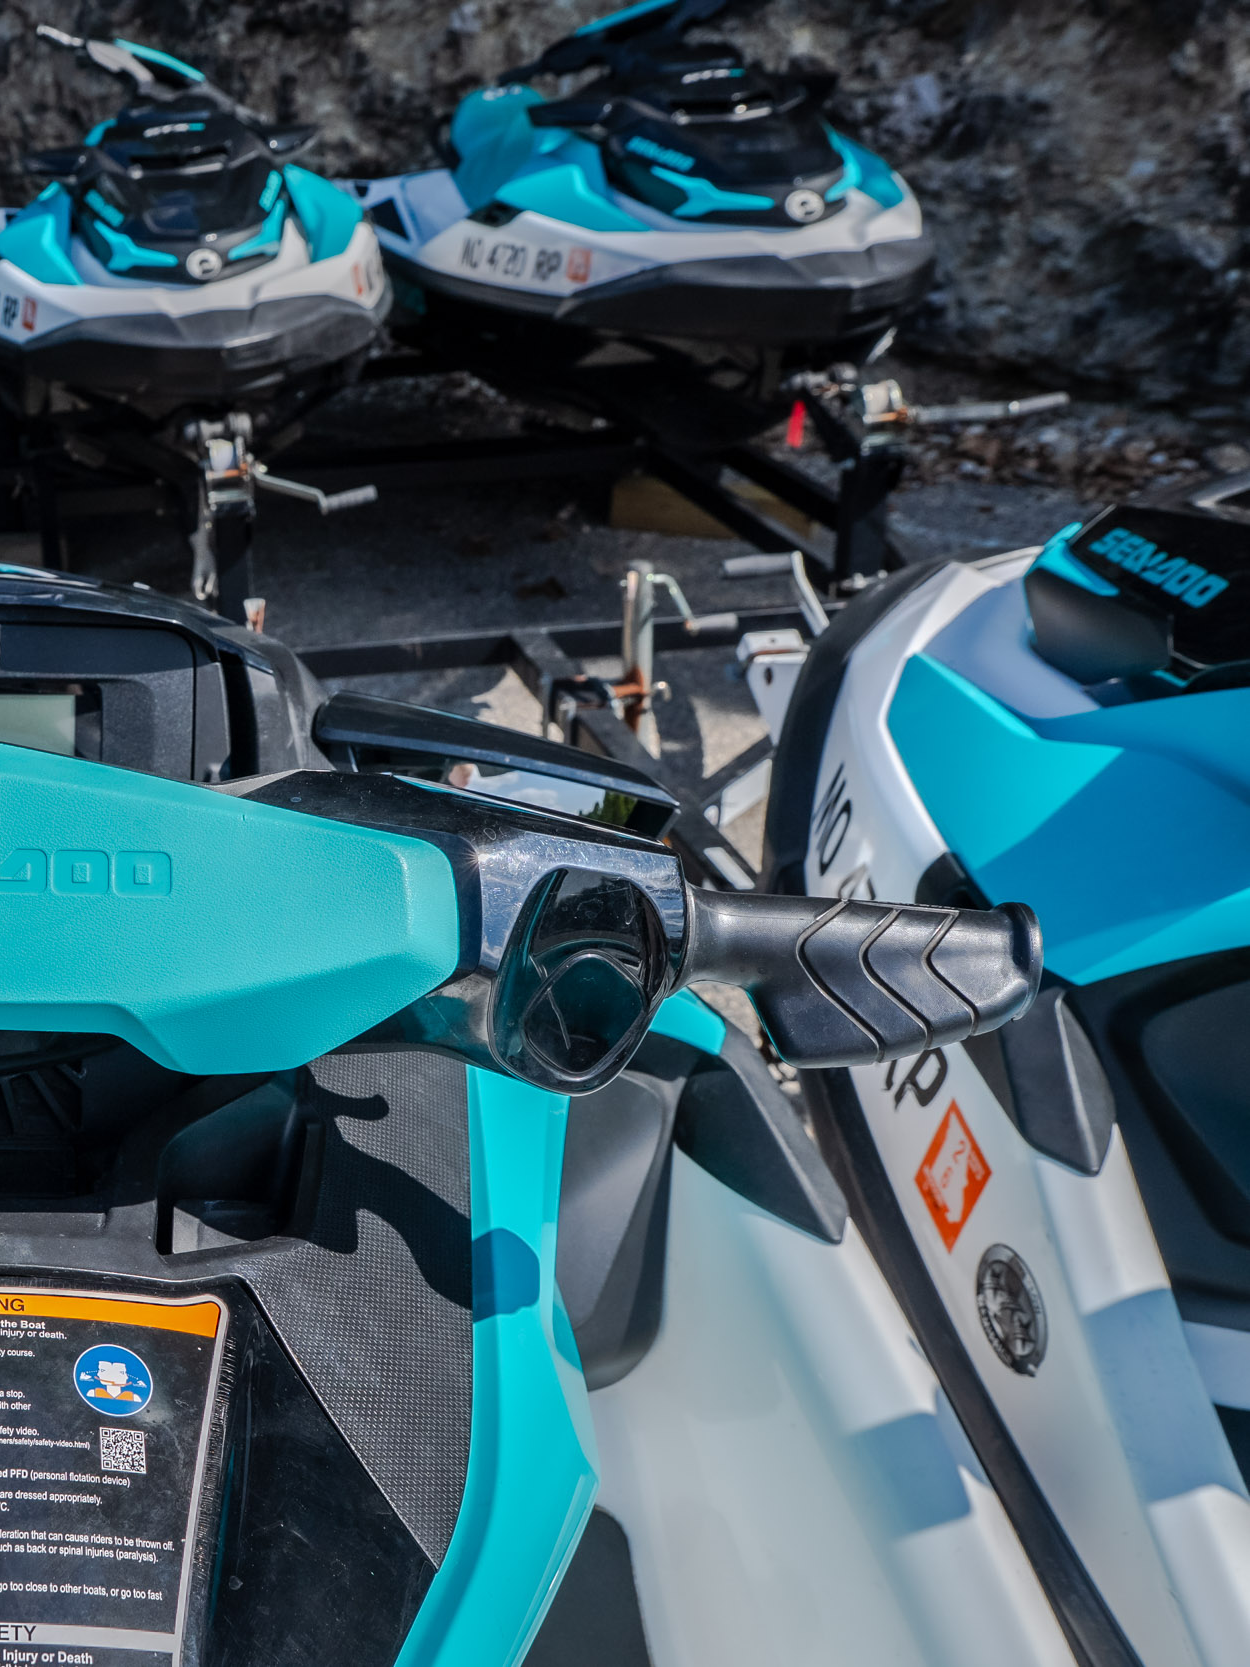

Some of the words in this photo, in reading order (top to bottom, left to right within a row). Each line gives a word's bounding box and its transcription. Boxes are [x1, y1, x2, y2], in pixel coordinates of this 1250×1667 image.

[884, 1047, 948, 1112] P
[0, 1319, 17, 1328] the
[20, 1320, 45, 1330] Boat
[0, 1328, 25, 1338] injury
[39, 1330, 66, 1339] death.
[16, 1426, 39, 1435] video.
[10, 1469, 28, 1478] PFD
[30, 1470, 67, 1482] (personal
[69, 1472, 100, 1483] flotation
[102, 1475, 130, 1488] device)
[31, 1530, 46, 1540] that
[48, 1533, 63, 1541] can
[65, 1534, 89, 1542] cause
[90, 1534, 113, 1544] riders
[114, 1536, 122, 1545] to
[124, 1536, 134, 1546] be
[135, 1538, 161, 1549] thrown
[163, 1540, 174, 1551] off.
[10, 1582, 23, 1591] too
[25, 1582, 47, 1592] close
[49, 1583, 58, 1592] to
[60, 1583, 81, 1594] other
[83, 1585, 108, 1598] boats,
[110, 1588, 119, 1596] or
[120, 1589, 131, 1600] go
[133, 1588, 146, 1599] too
[147, 1590, 162, 1601] fast
[3, 1648, 38, 1663] Injury
[41, 1652, 54, 1662] or
[58, 1650, 93, 1665] Death
